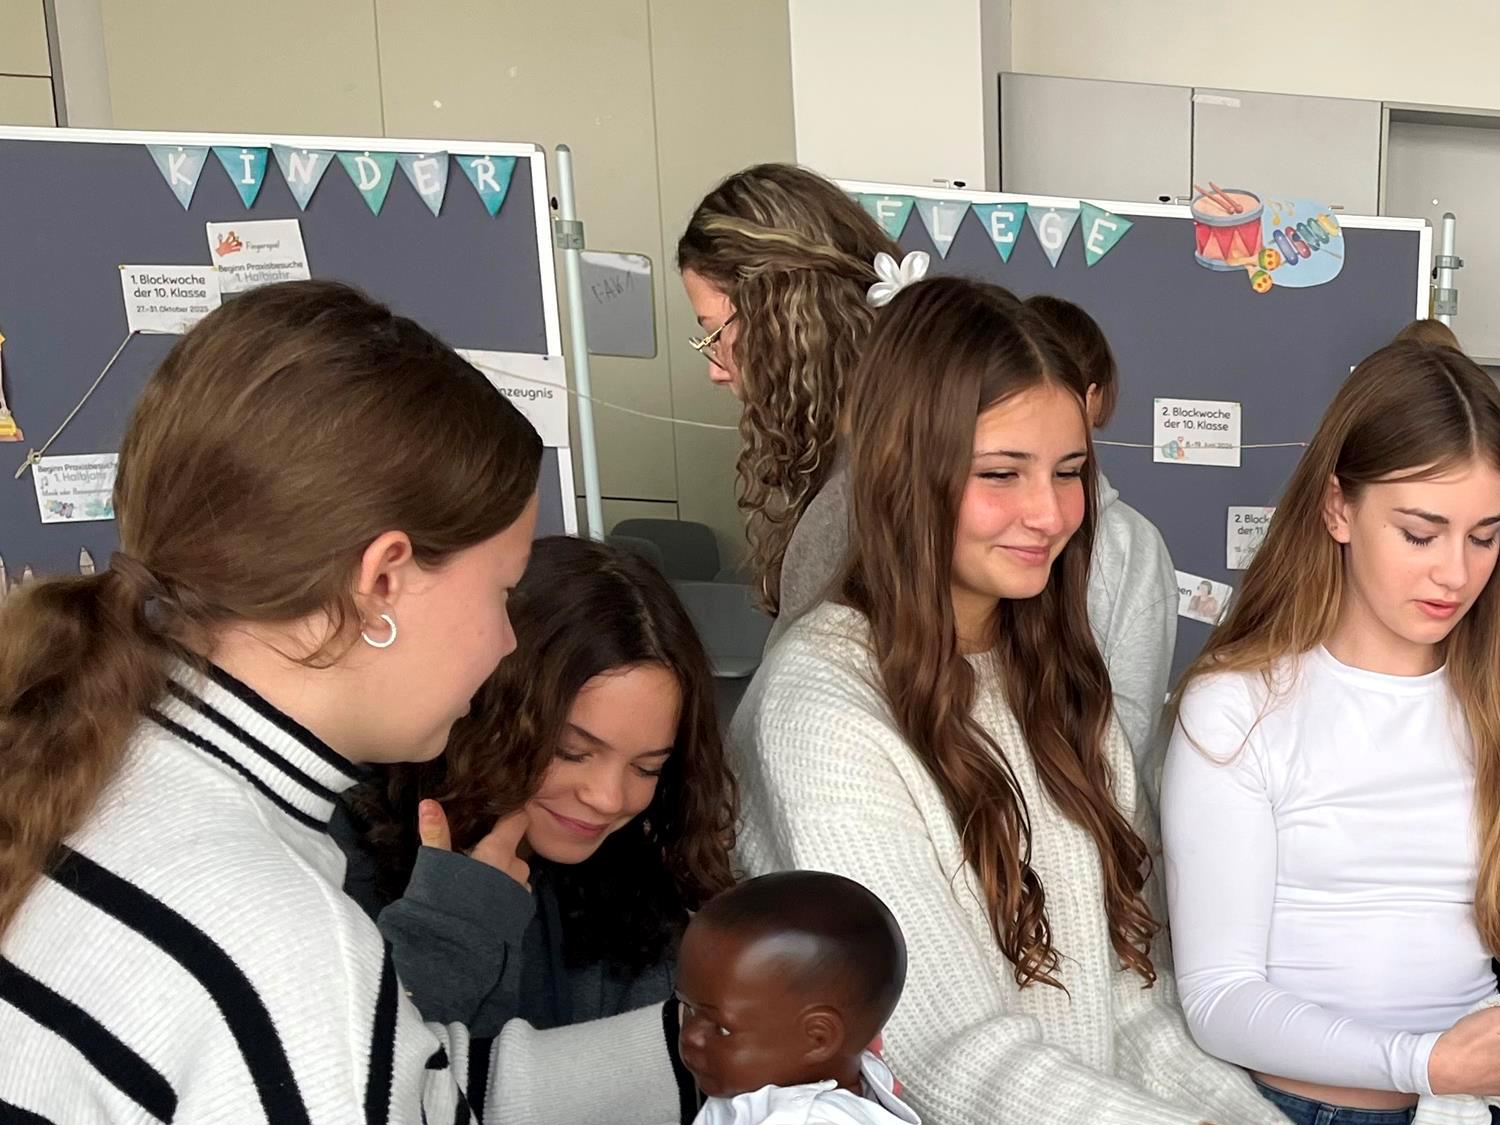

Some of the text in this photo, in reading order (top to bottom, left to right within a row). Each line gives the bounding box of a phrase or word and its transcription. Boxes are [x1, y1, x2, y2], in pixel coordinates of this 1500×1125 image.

[167, 152, 502, 196] KINDER
[876, 199, 1118, 255] FLEGE
[218, 260, 304, 274] Beginn Praxisbesuche
[130, 274, 206, 285] 1. Blockwoche
[244, 270, 290, 284] Halbjahr
[133, 287, 207, 299] der 10. Klasse
[159, 305, 188, 313] Oktober
[499, 385, 554, 401] nzeugnis
[1161, 406, 1231, 420] 2. Blockwoche
[1163, 419, 1229, 431] der 10. Klasse
[1244, 513, 1270, 524] Block
[1237, 527, 1253, 535] der
